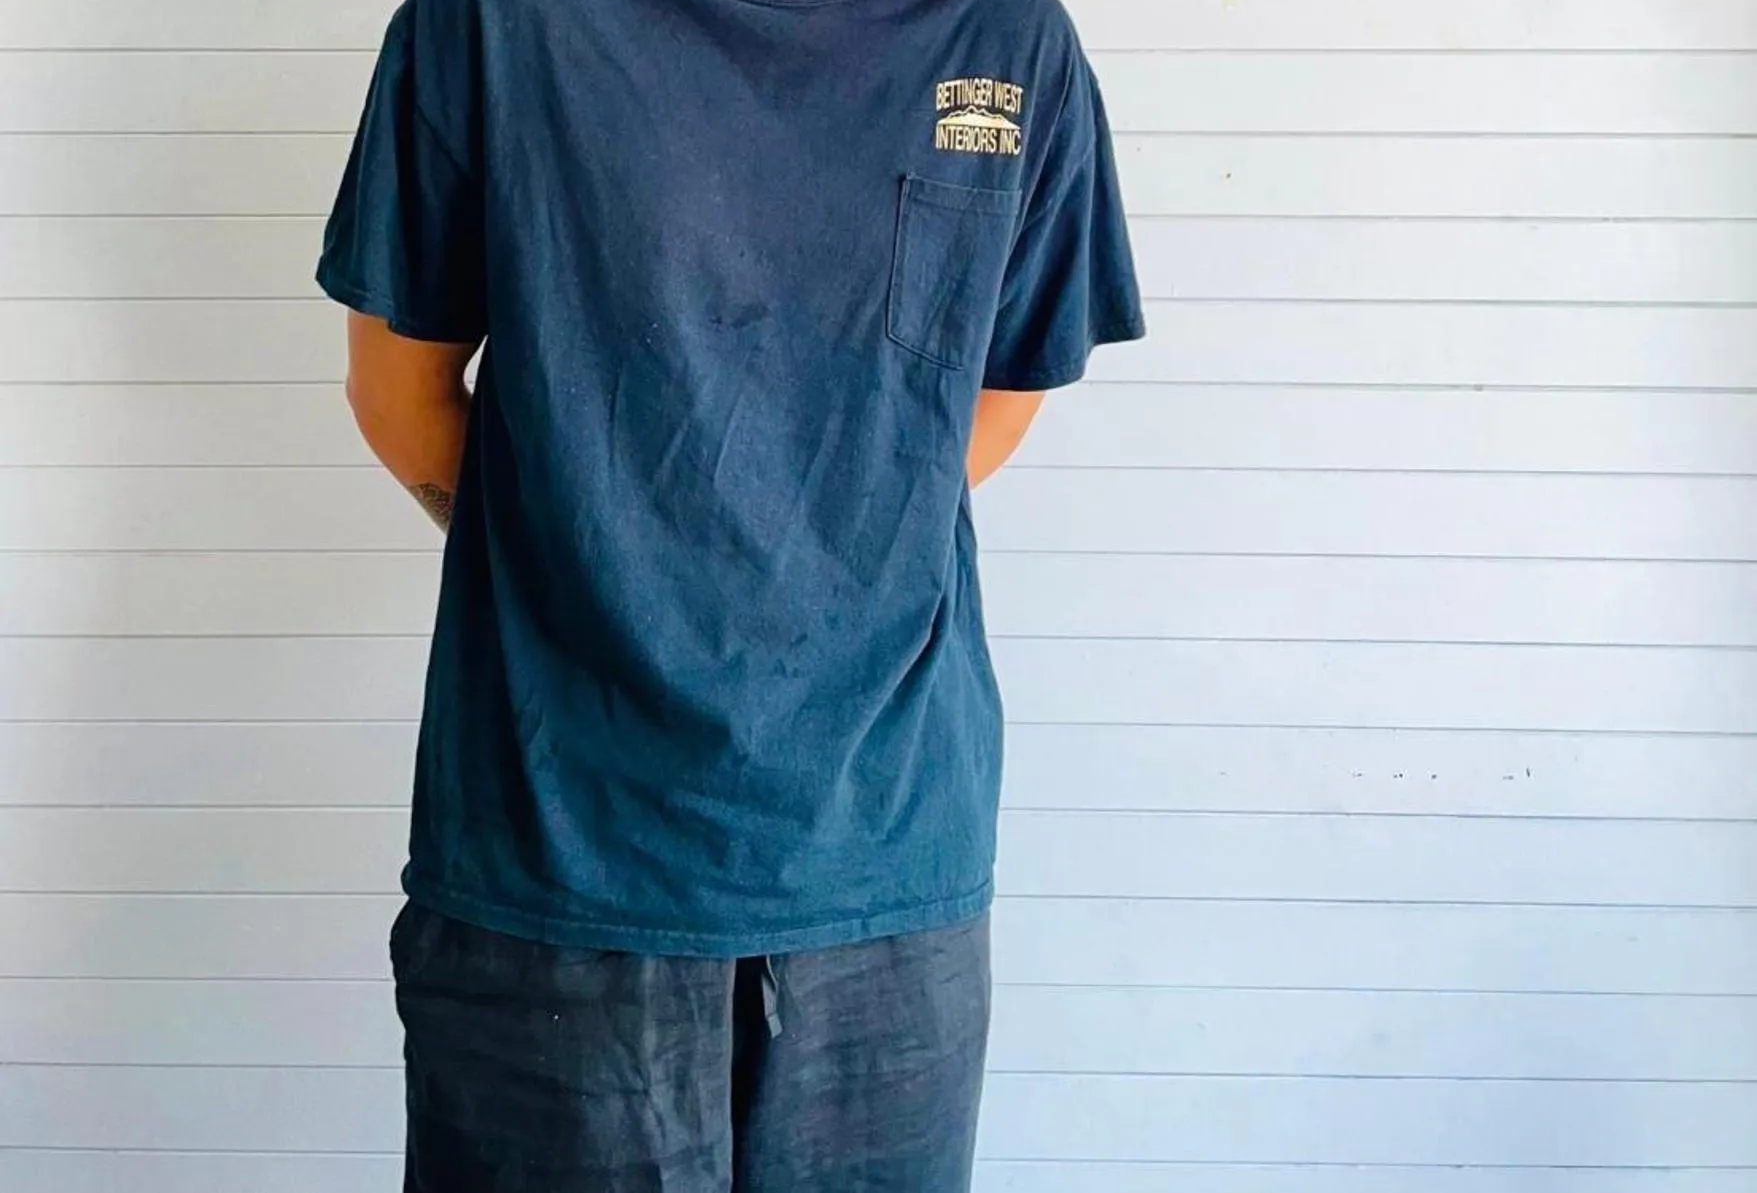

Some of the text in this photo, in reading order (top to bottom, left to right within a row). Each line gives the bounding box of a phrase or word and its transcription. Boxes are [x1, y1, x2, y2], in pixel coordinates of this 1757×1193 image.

[936, 78, 1023, 114] BETTINGER WEST
[935, 124, 1021, 155] INTERIORS INC
